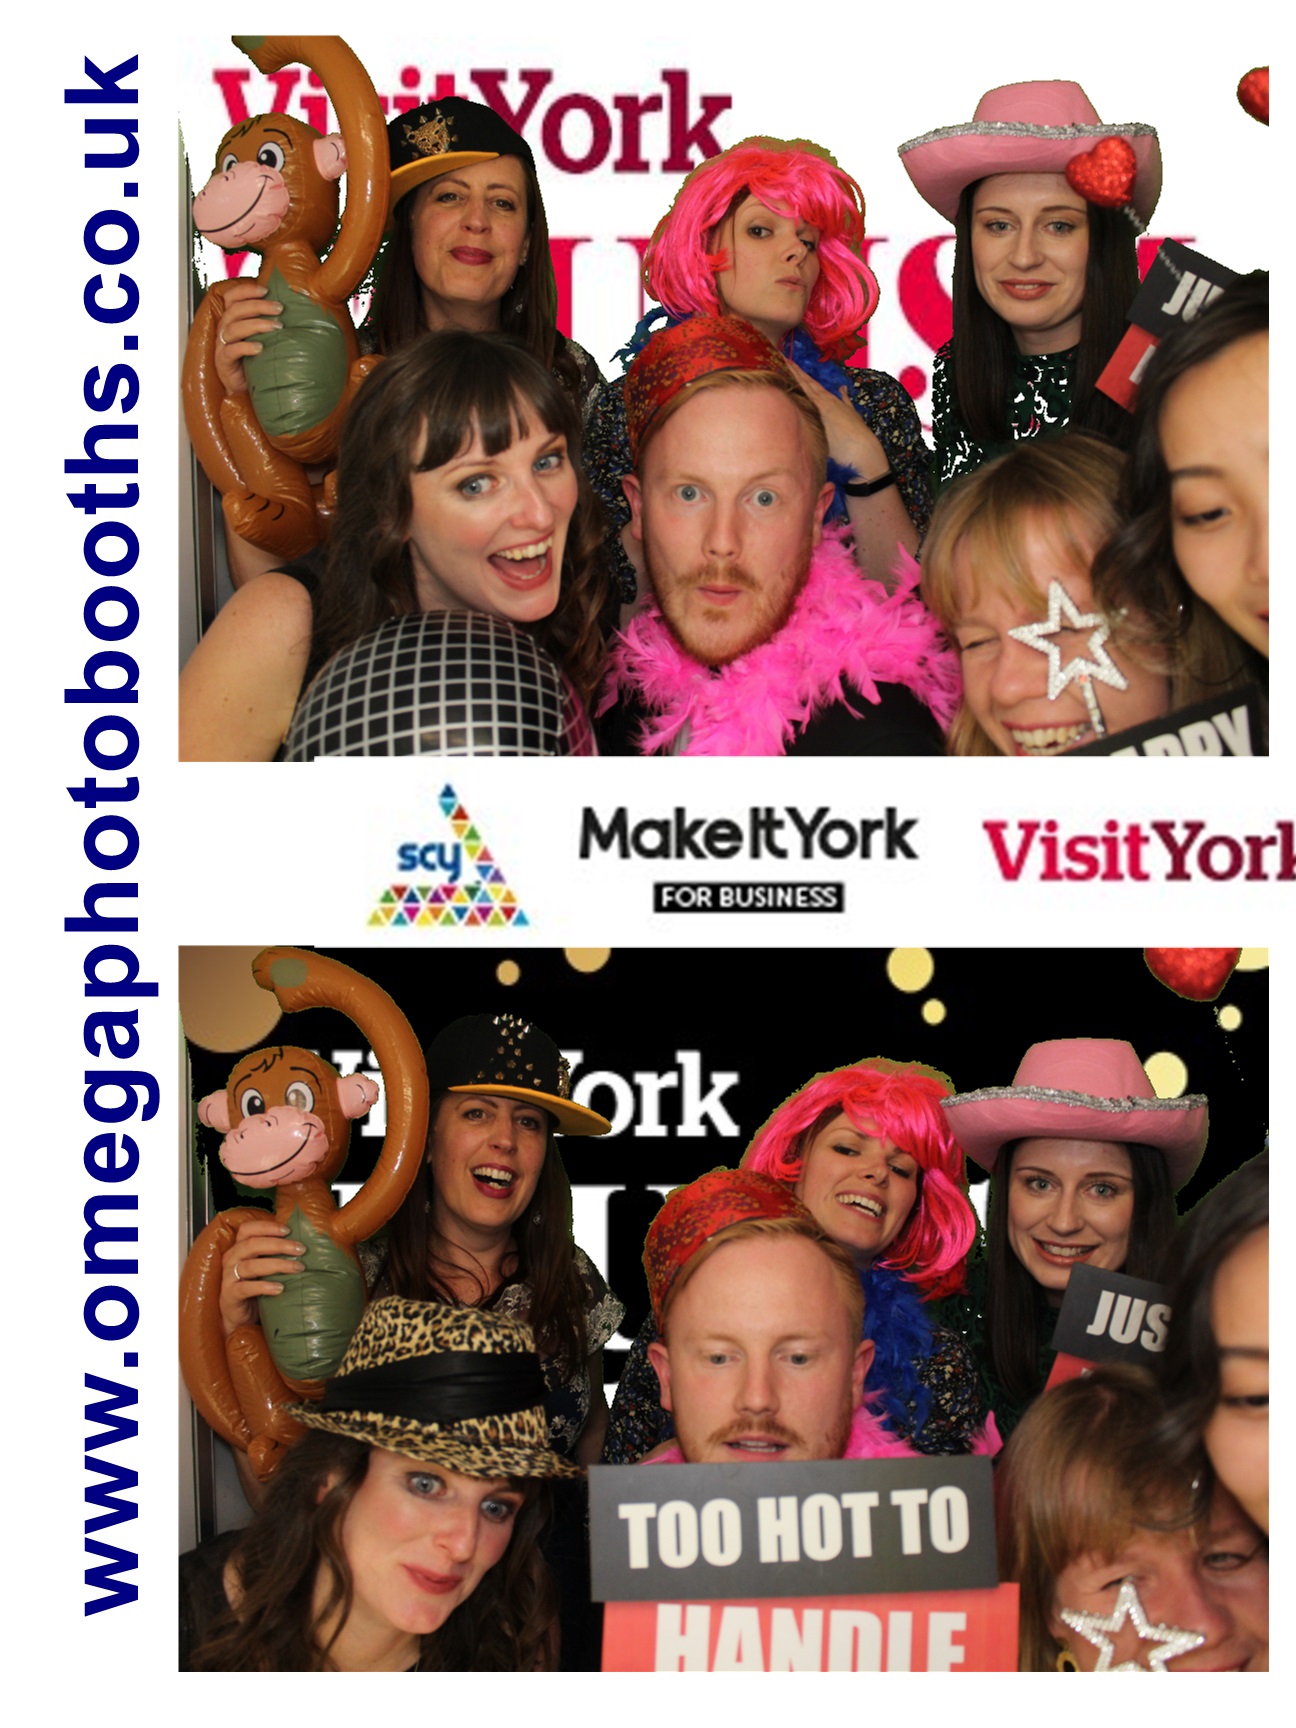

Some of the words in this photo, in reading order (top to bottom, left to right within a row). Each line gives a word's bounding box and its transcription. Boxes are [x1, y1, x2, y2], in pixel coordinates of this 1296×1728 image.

[619, 1498, 742, 1569] TOO
[757, 1491, 879, 1563] HOT
[890, 1485, 970, 1555] TO
[655, 1603, 967, 1672] HANDLE
